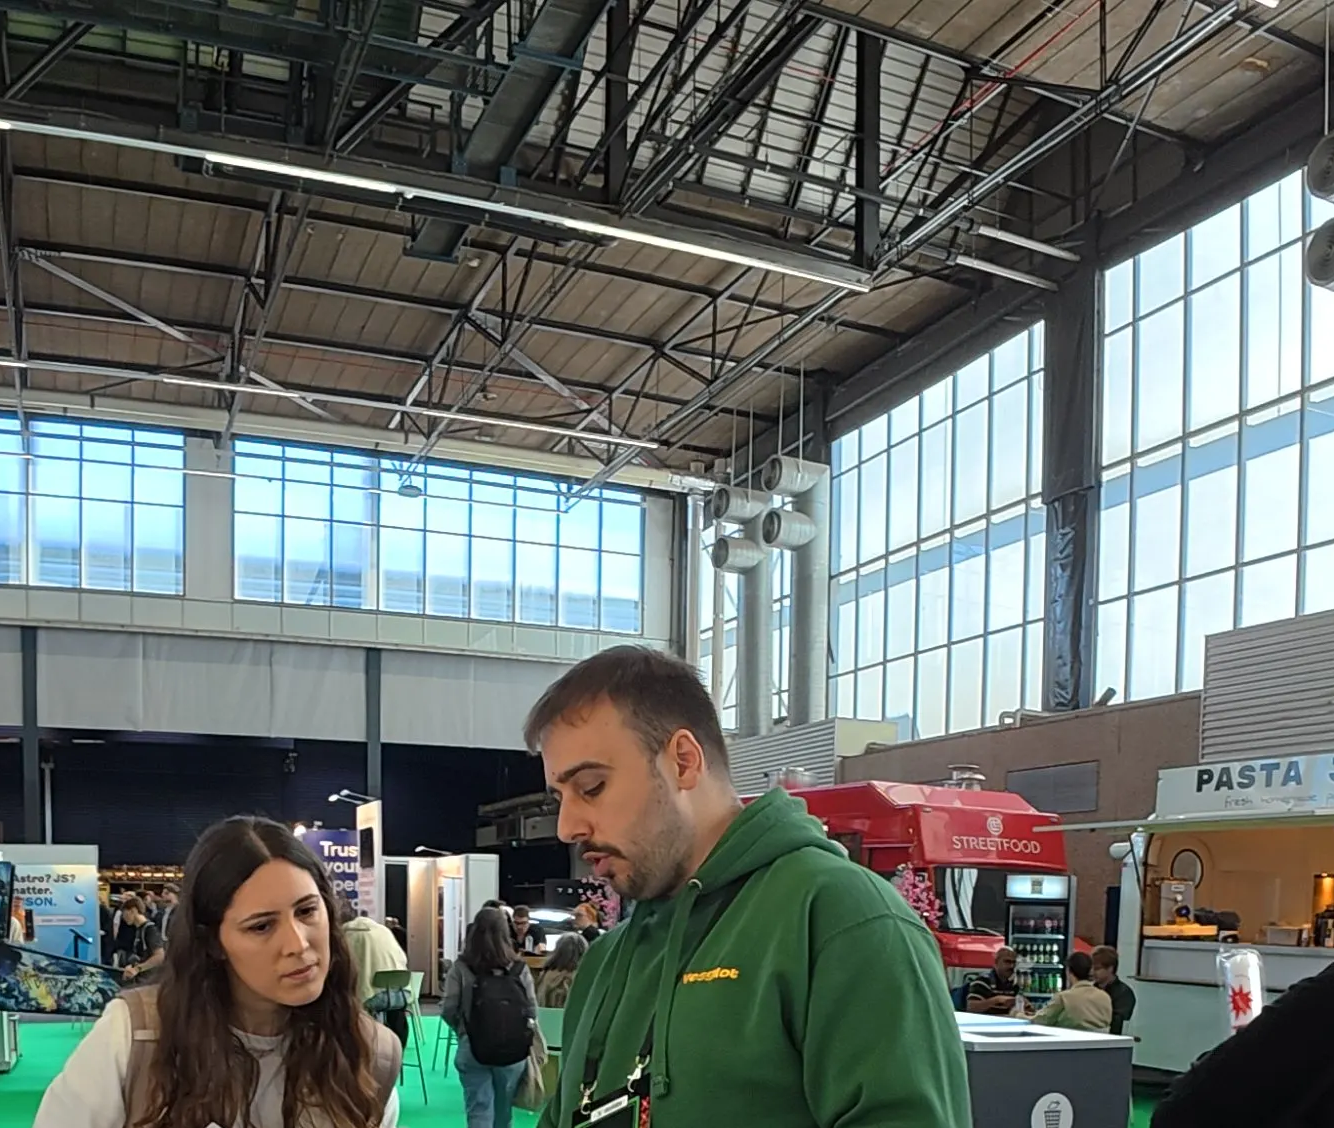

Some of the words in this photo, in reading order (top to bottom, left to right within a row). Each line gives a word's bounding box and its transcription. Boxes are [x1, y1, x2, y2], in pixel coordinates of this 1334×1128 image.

[1196, 761, 1302, 792] PASTA
[1224, 796, 1253, 808] fresh
[319, 841, 358, 857] Trus
[952, 835, 1040, 854] STREETFOOD
[53, 874, 76, 883] JS?
[23, 897, 57, 907] SON.
